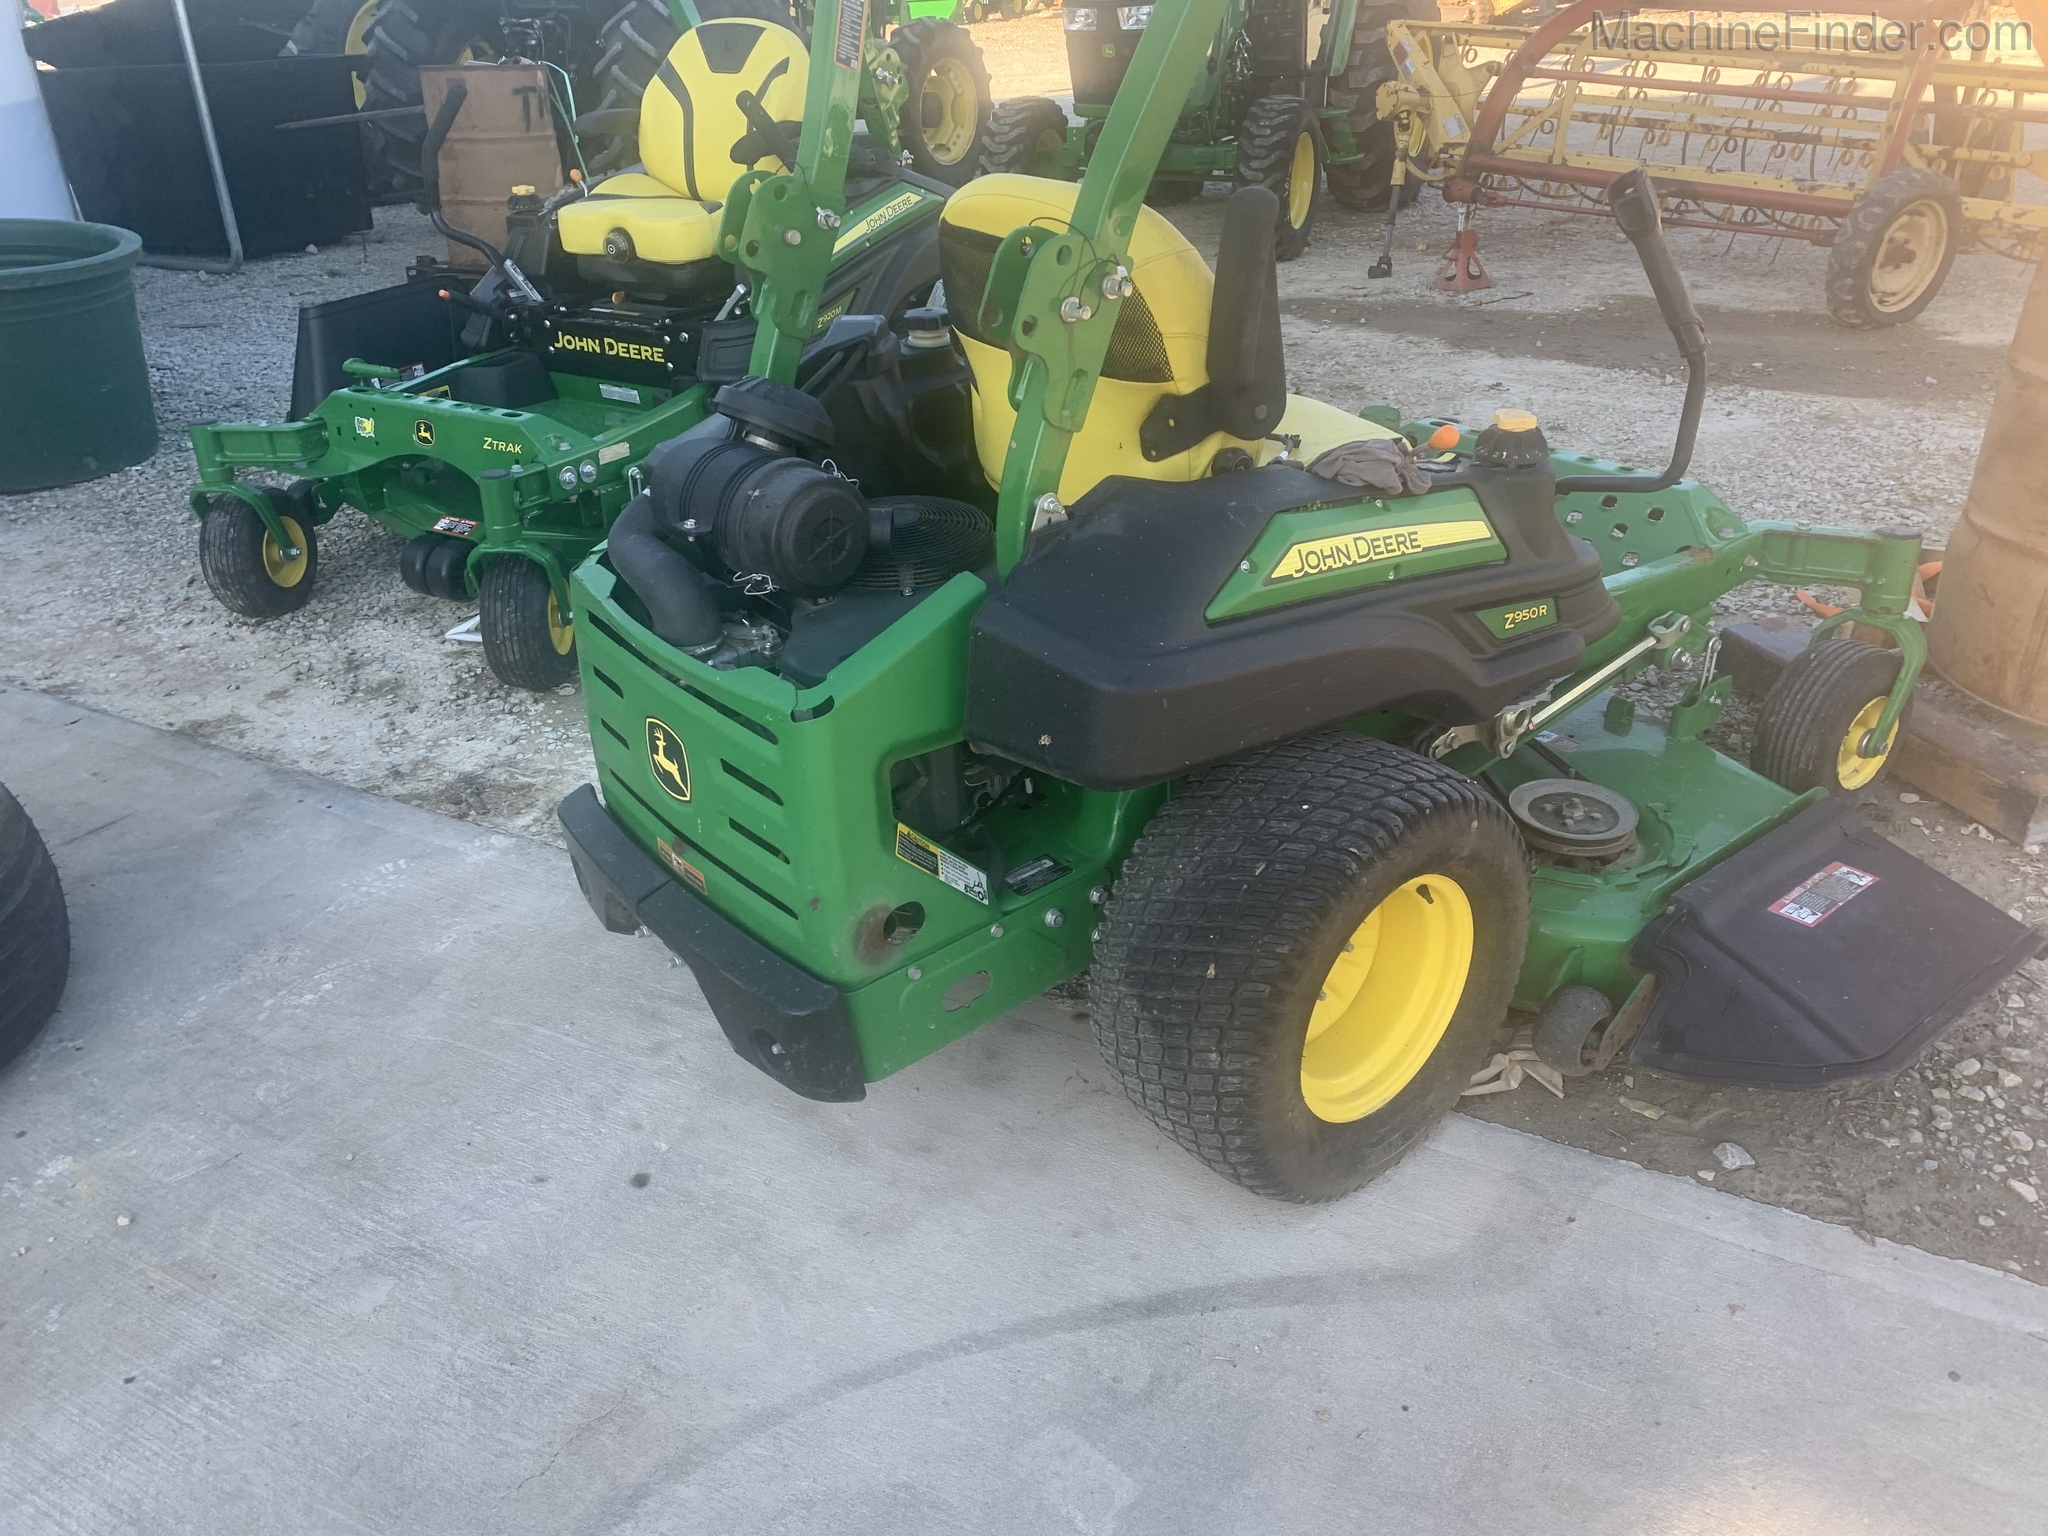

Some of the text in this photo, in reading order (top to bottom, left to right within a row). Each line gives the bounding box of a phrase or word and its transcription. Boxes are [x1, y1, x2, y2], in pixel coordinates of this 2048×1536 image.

[865, 196, 914, 232] JOHN DEERE
[817, 305, 842, 329] Z920M
[554, 331, 665, 363] JOHN DEERE
[483, 437, 523, 454] ZTRAK
[1294, 530, 1422, 574] JOHN DEERE
[1504, 604, 1547, 630] Z950R
